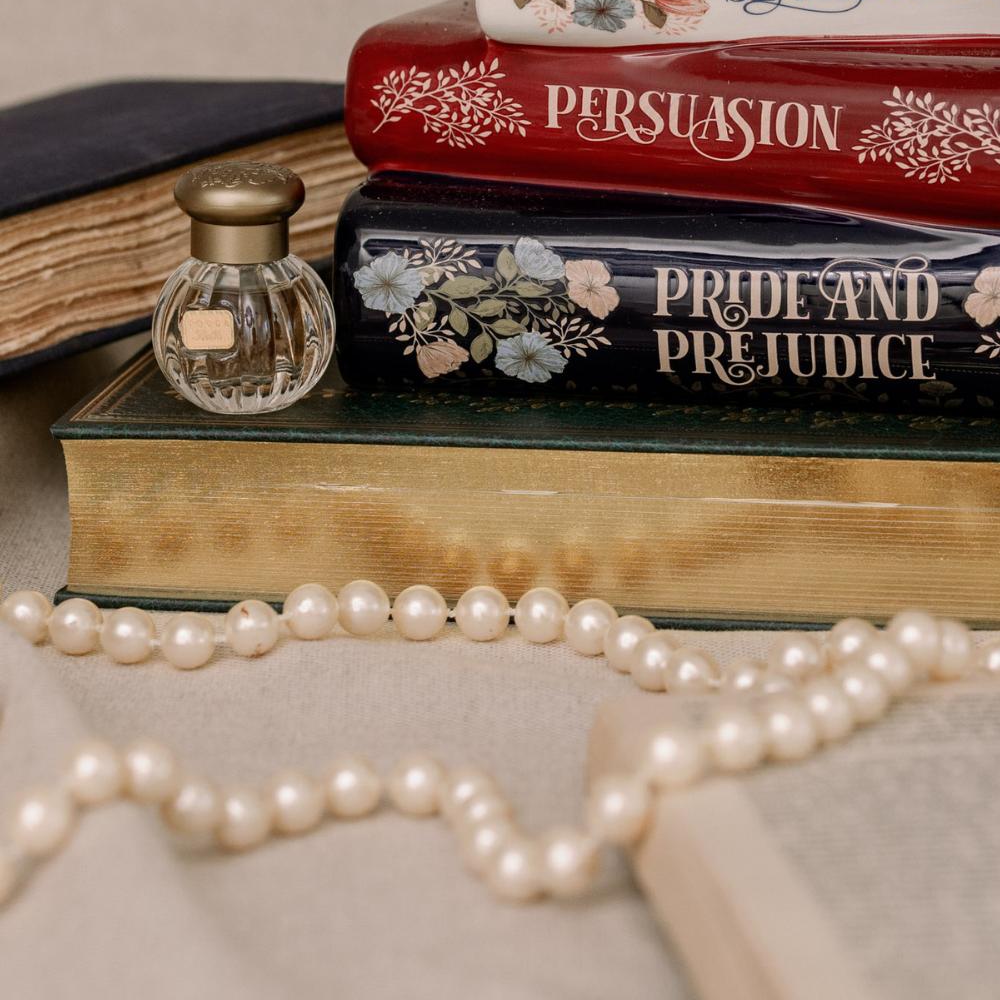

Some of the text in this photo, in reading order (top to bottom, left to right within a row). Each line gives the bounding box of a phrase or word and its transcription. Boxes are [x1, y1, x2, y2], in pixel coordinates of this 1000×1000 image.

[544, 84, 844, 162] PERSUASION
[653, 256, 939, 331] PRIDE AND
[653, 329, 937, 386] PREJUDICE
